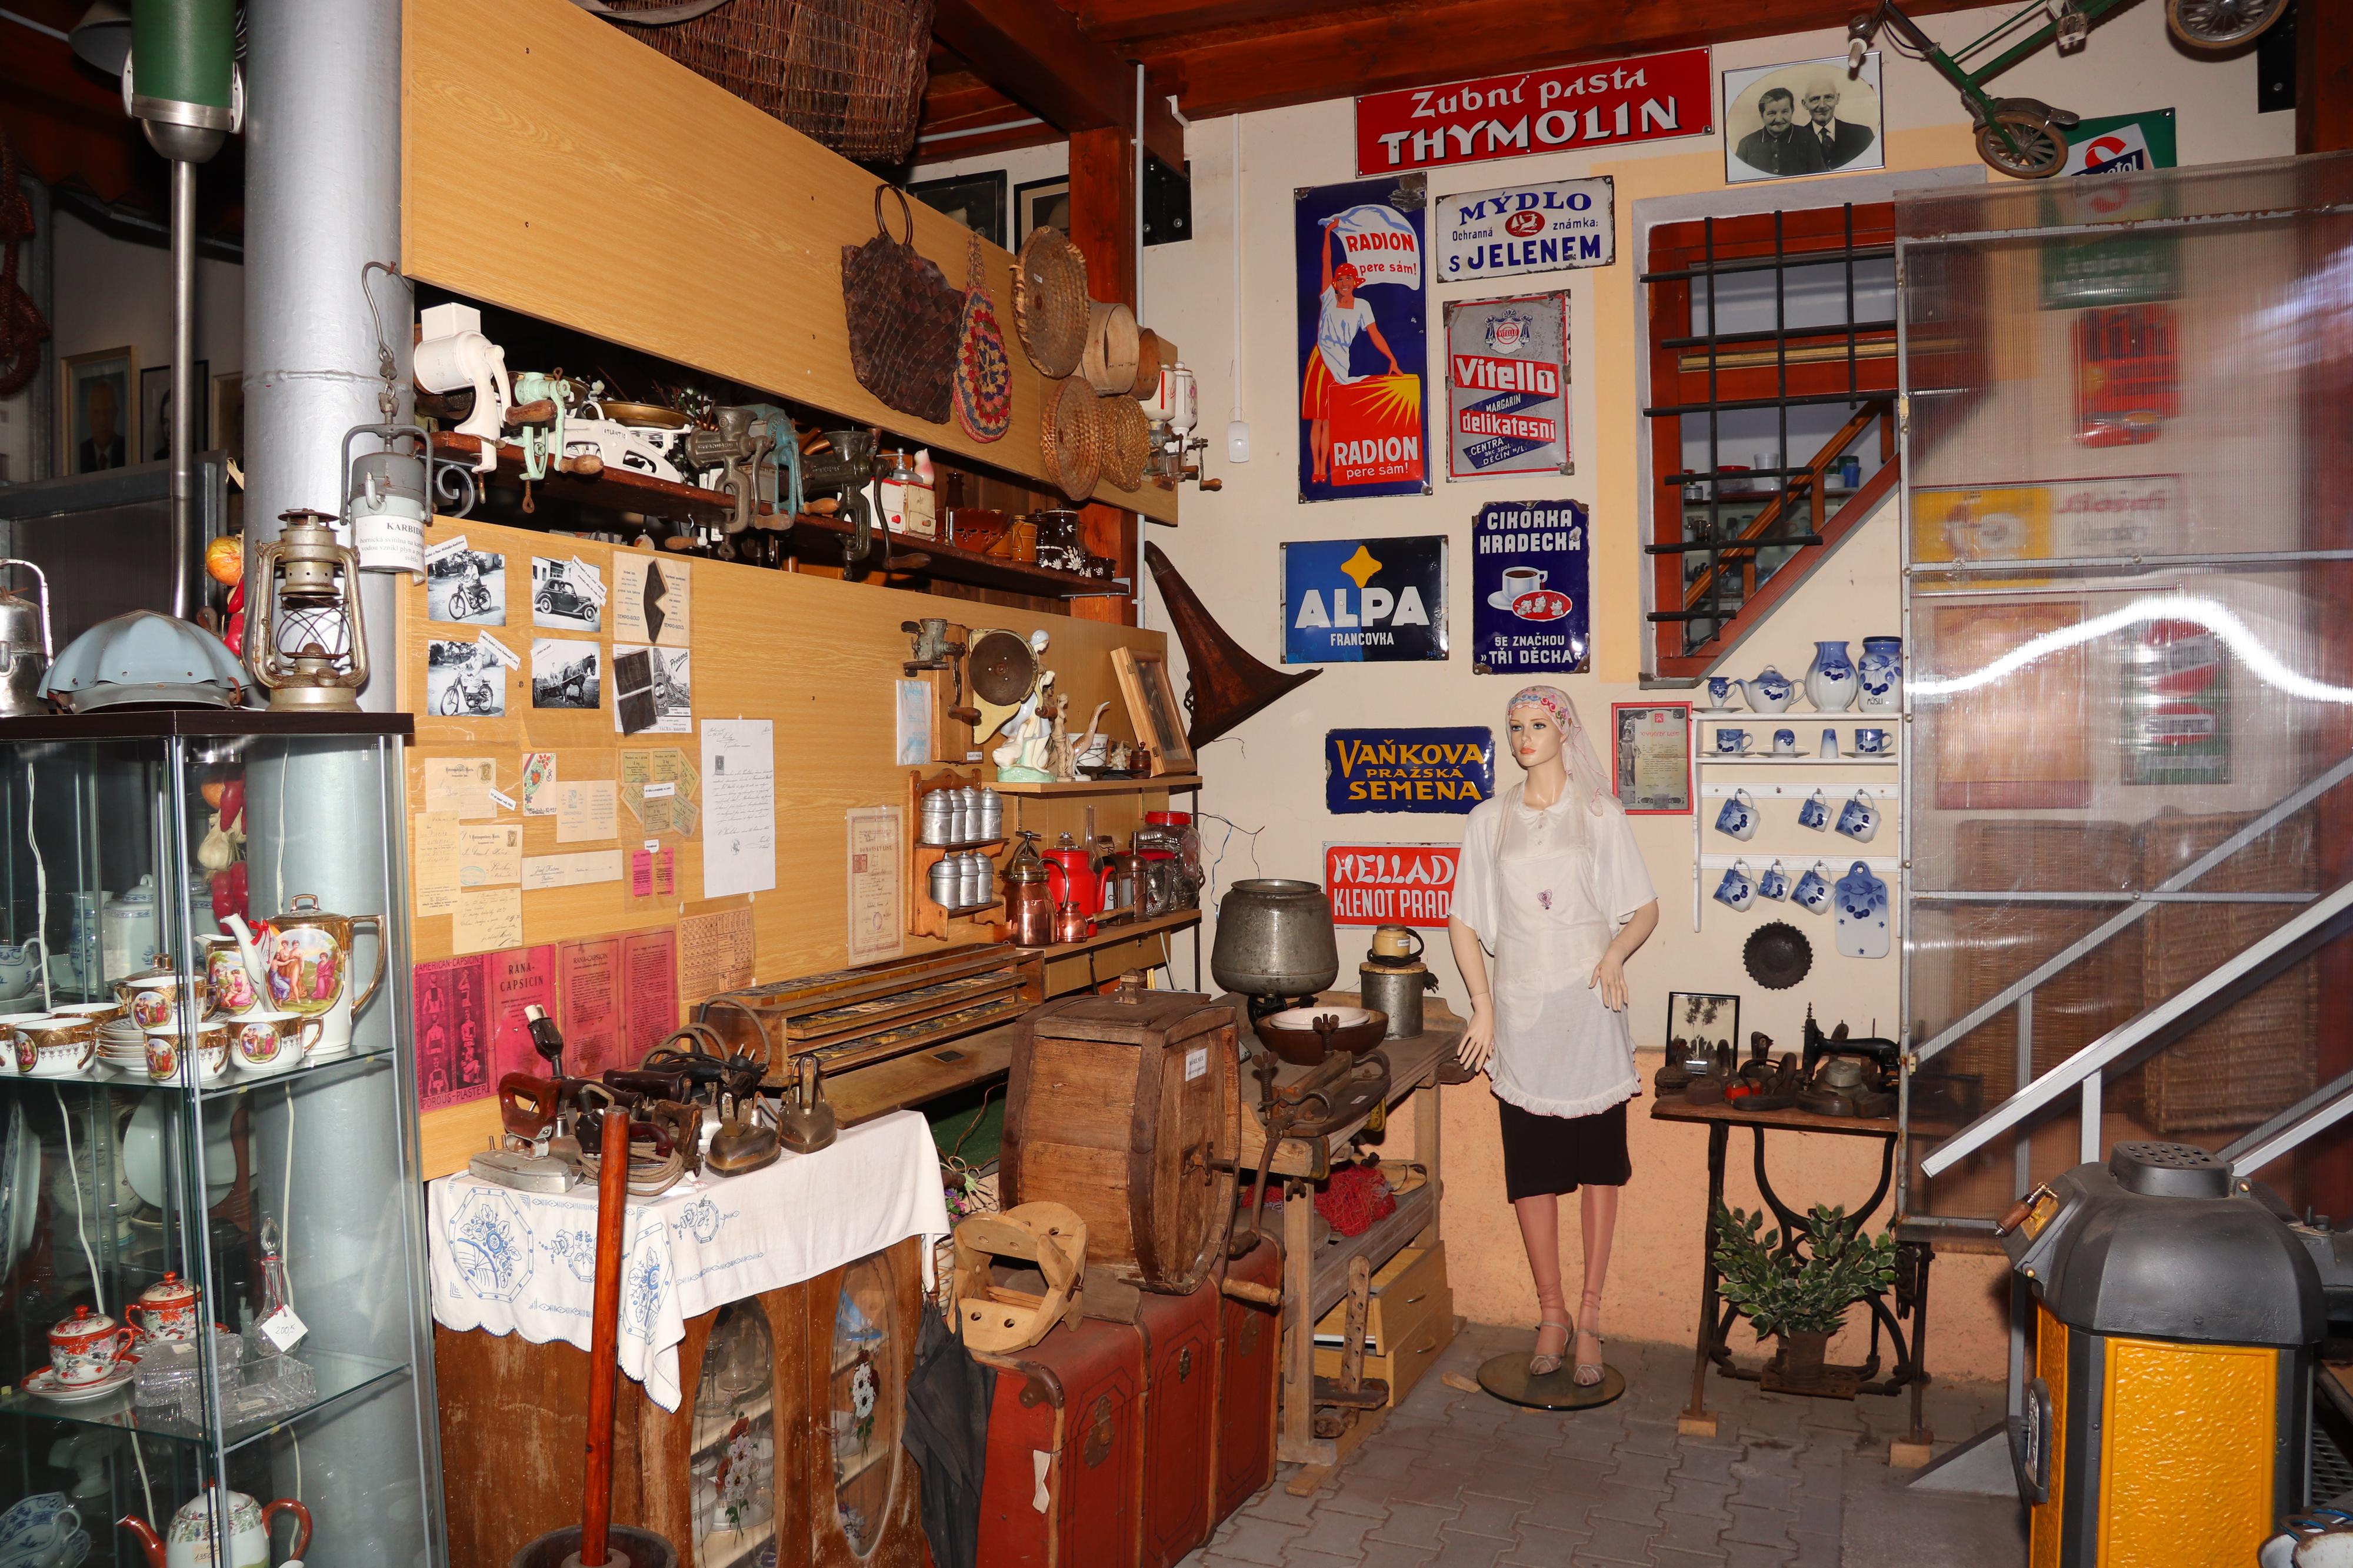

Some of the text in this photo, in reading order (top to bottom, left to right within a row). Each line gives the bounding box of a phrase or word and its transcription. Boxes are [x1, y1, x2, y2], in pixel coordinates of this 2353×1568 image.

[1411, 66, 1648, 118] Zubní pasta
[1378, 95, 1679, 164] THYMOLIN
[1459, 191, 1592, 226] MÝDLO
[1452, 217, 1598, 241] Ochranná známka:
[1345, 232, 1415, 252] RADION
[1468, 234, 1601, 269] JELENEM
[1359, 261, 1417, 276] pere sám!
[1498, 329, 1517, 337] VITELLO
[1455, 358, 1556, 393] Vitello
[1486, 393, 1521, 412] MARGARIN
[1462, 412, 1555, 439] delikatesní
[1334, 436, 1418, 466] RADION
[1347, 462, 1408, 481] pere sám!
[1487, 509, 1572, 530] CIKORKA
[400, 546, 412, 554] plyn
[1294, 586, 1430, 629] ALPA
[1330, 632, 1395, 646] FRANCOVKA
[1495, 632, 1565, 646] SE ZNAČKOU
[1335, 739, 1485, 778] VAŇKOVA
[1365, 765, 1464, 778] PRAŽSKÁ
[1348, 780, 1482, 800] SEMENA
[1334, 888, 1454, 919] KLENOT PRAD
[509, 962, 535, 975] RANA-
[501, 975, 544, 992] CAPSICIN
